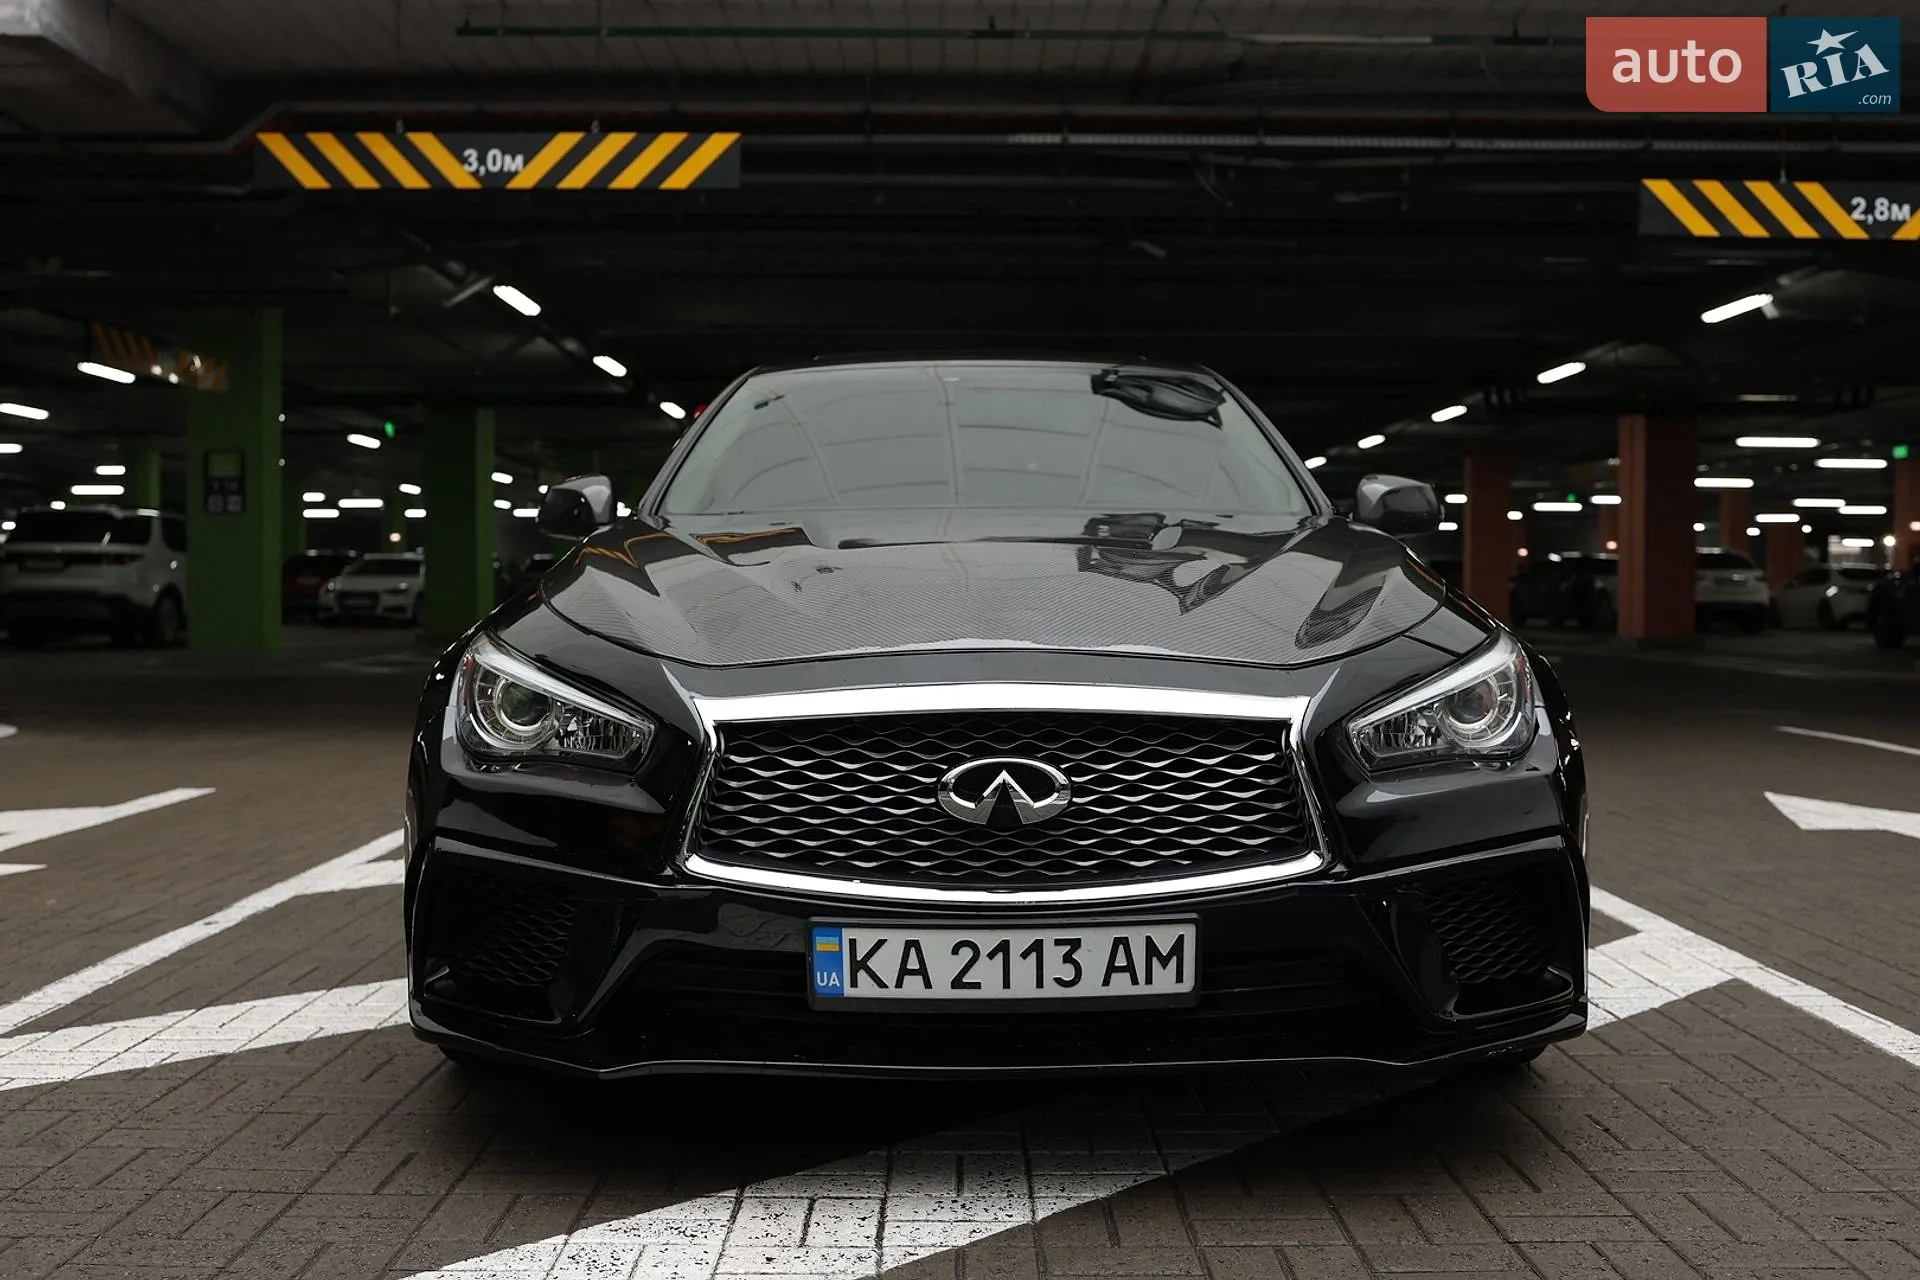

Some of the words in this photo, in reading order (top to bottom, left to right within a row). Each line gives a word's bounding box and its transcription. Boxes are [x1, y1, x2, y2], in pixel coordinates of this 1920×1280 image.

[816, 971, 840, 988] UA
[848, 937, 933, 990] KA
[950, 937, 1083, 990] 2113
[1101, 933, 1185, 987] AM
